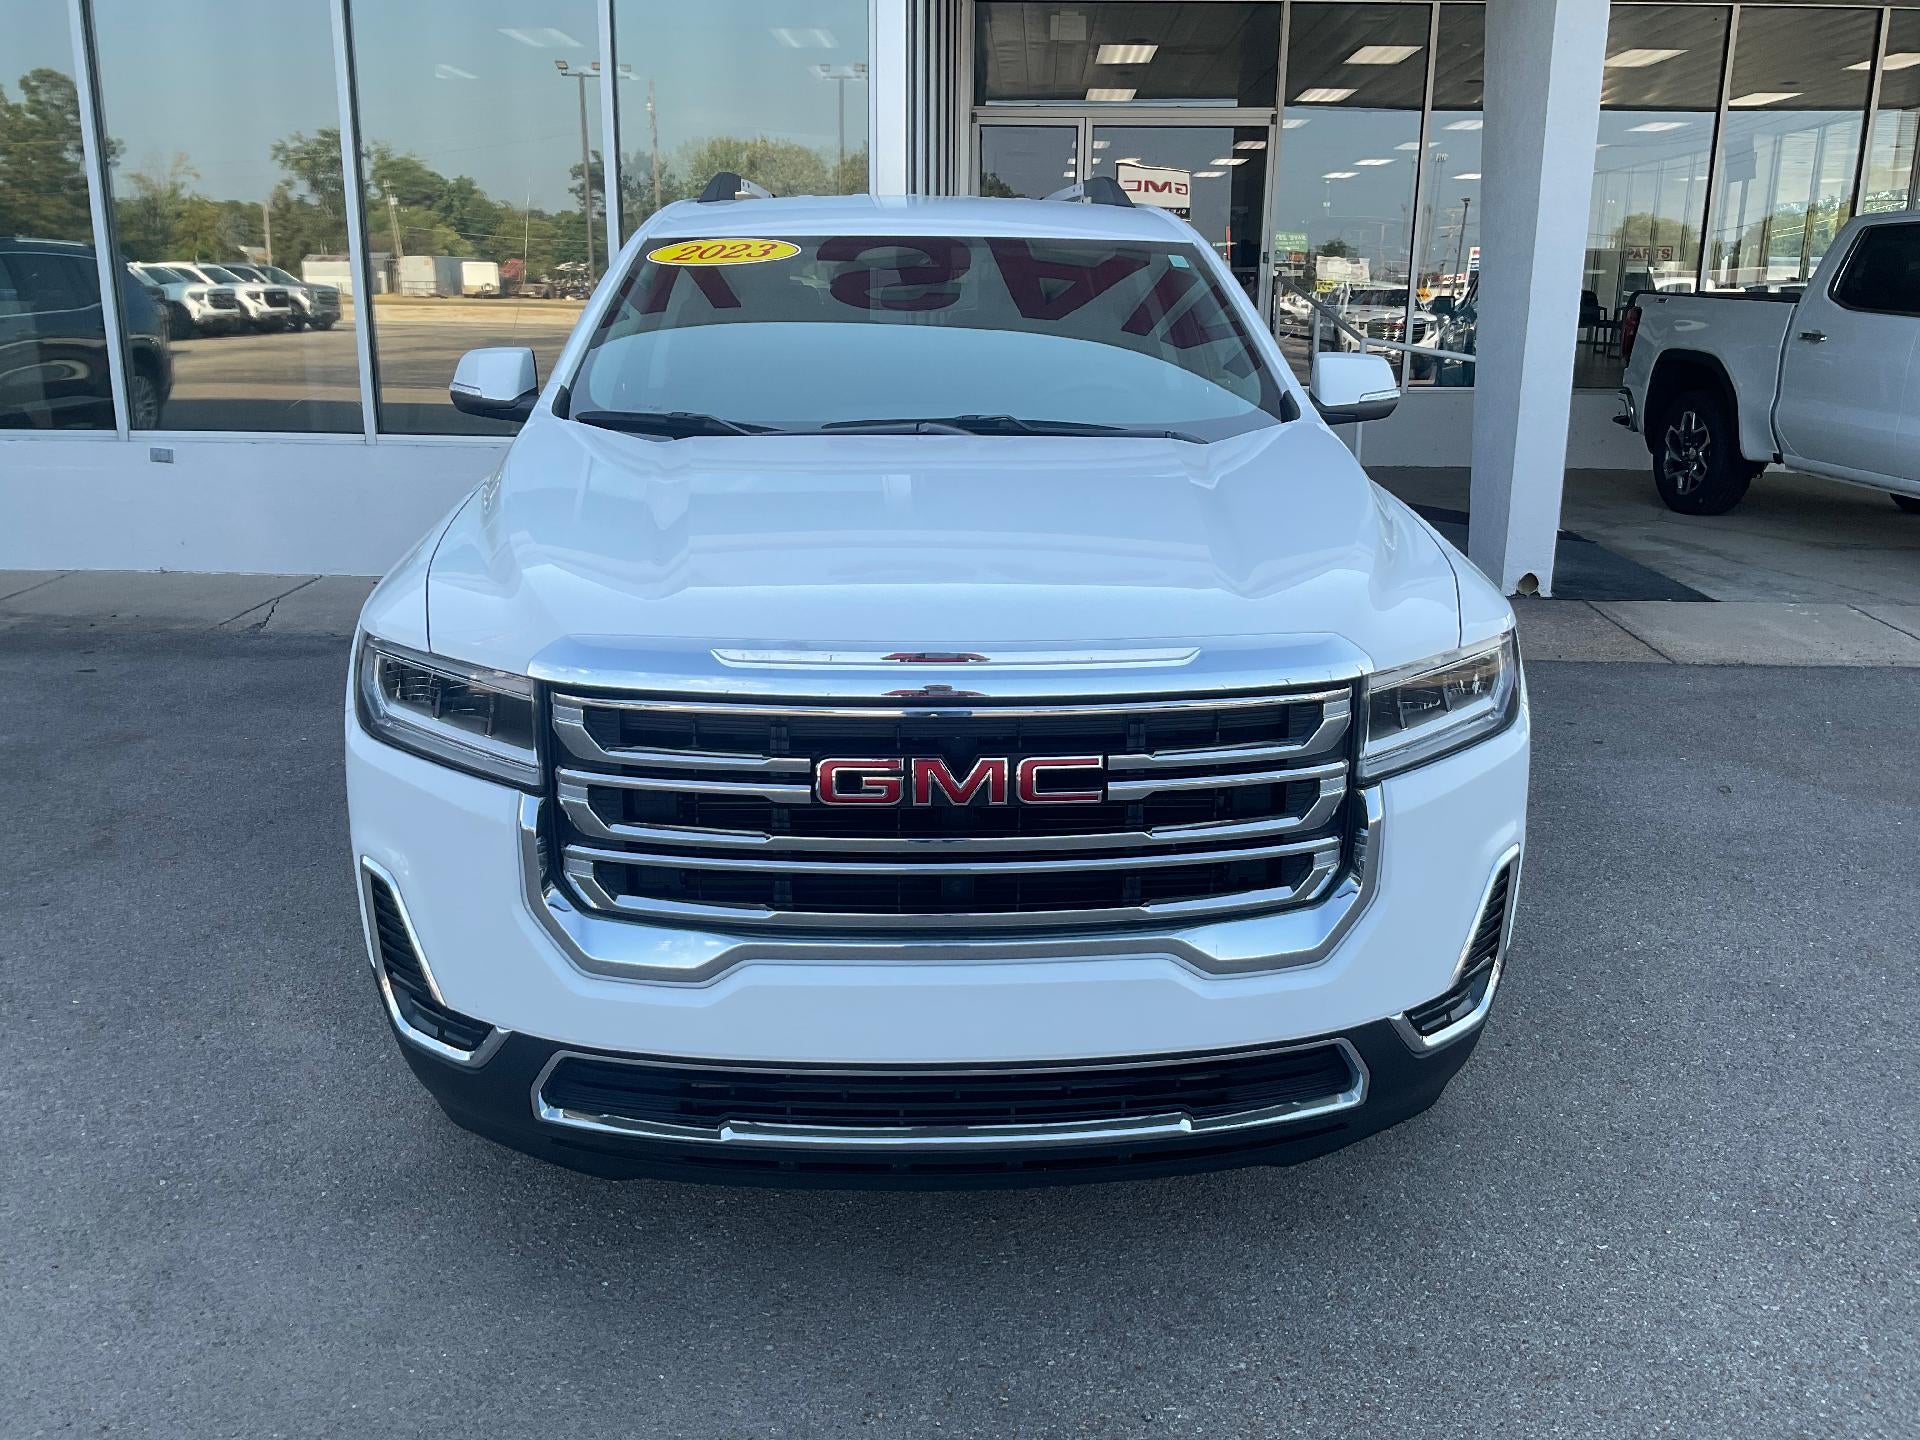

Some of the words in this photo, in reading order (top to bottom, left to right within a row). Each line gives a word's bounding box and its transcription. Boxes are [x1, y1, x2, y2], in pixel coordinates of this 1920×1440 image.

[671, 243, 778, 261] 2023
[1626, 247, 1671, 259] PARTS
[815, 754, 1103, 806] GMC
